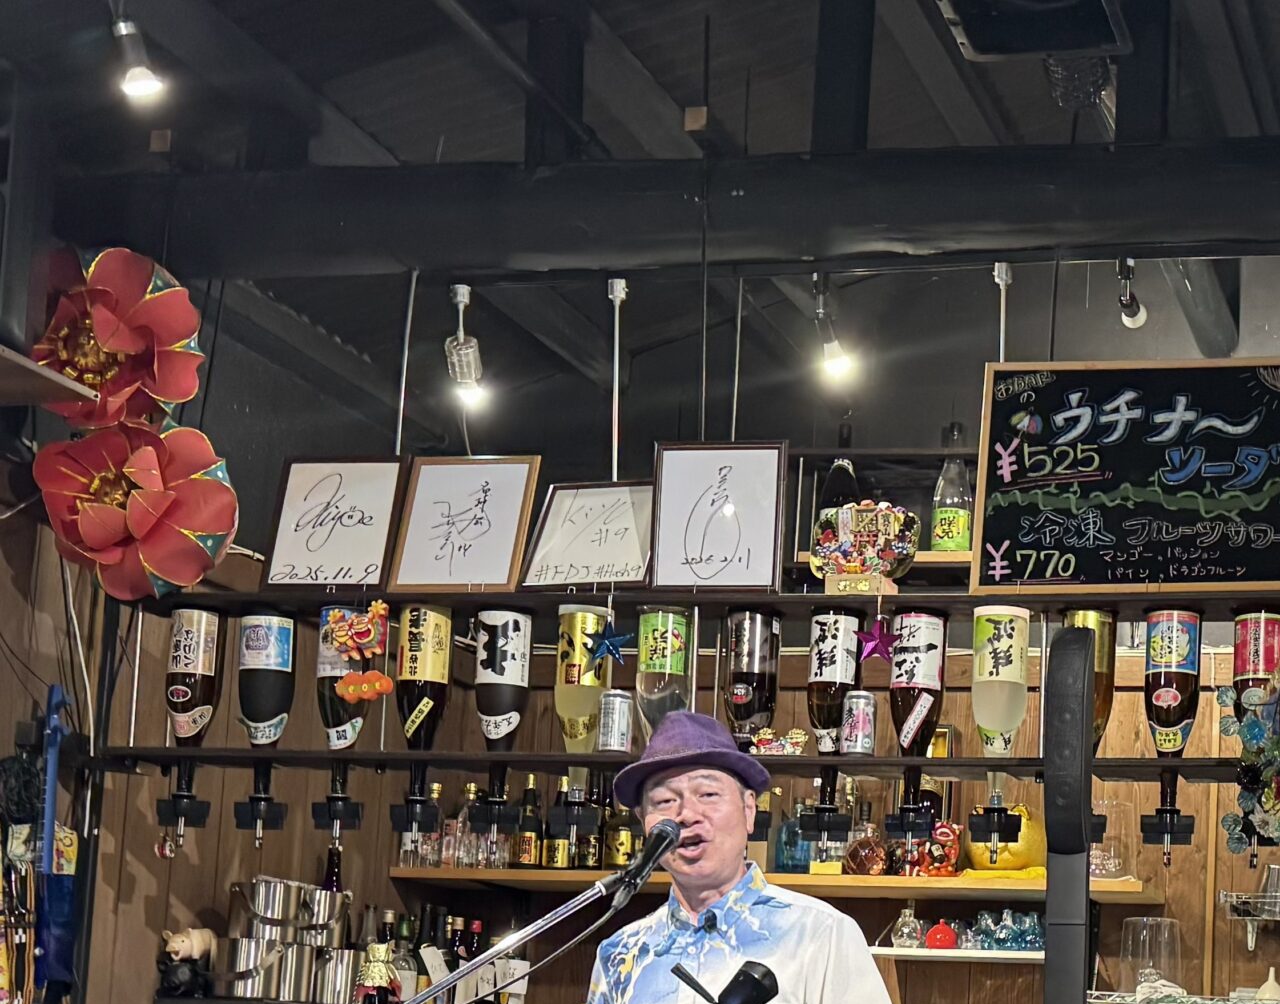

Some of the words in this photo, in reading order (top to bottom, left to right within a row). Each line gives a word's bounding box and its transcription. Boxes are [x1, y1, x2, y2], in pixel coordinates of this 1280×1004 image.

[1020, 391, 1035, 403] の
[1020, 508, 1116, 549] 冷凍
[986, 540, 1077, 582] ¥770
[985, 618, 1015, 678] 残波
